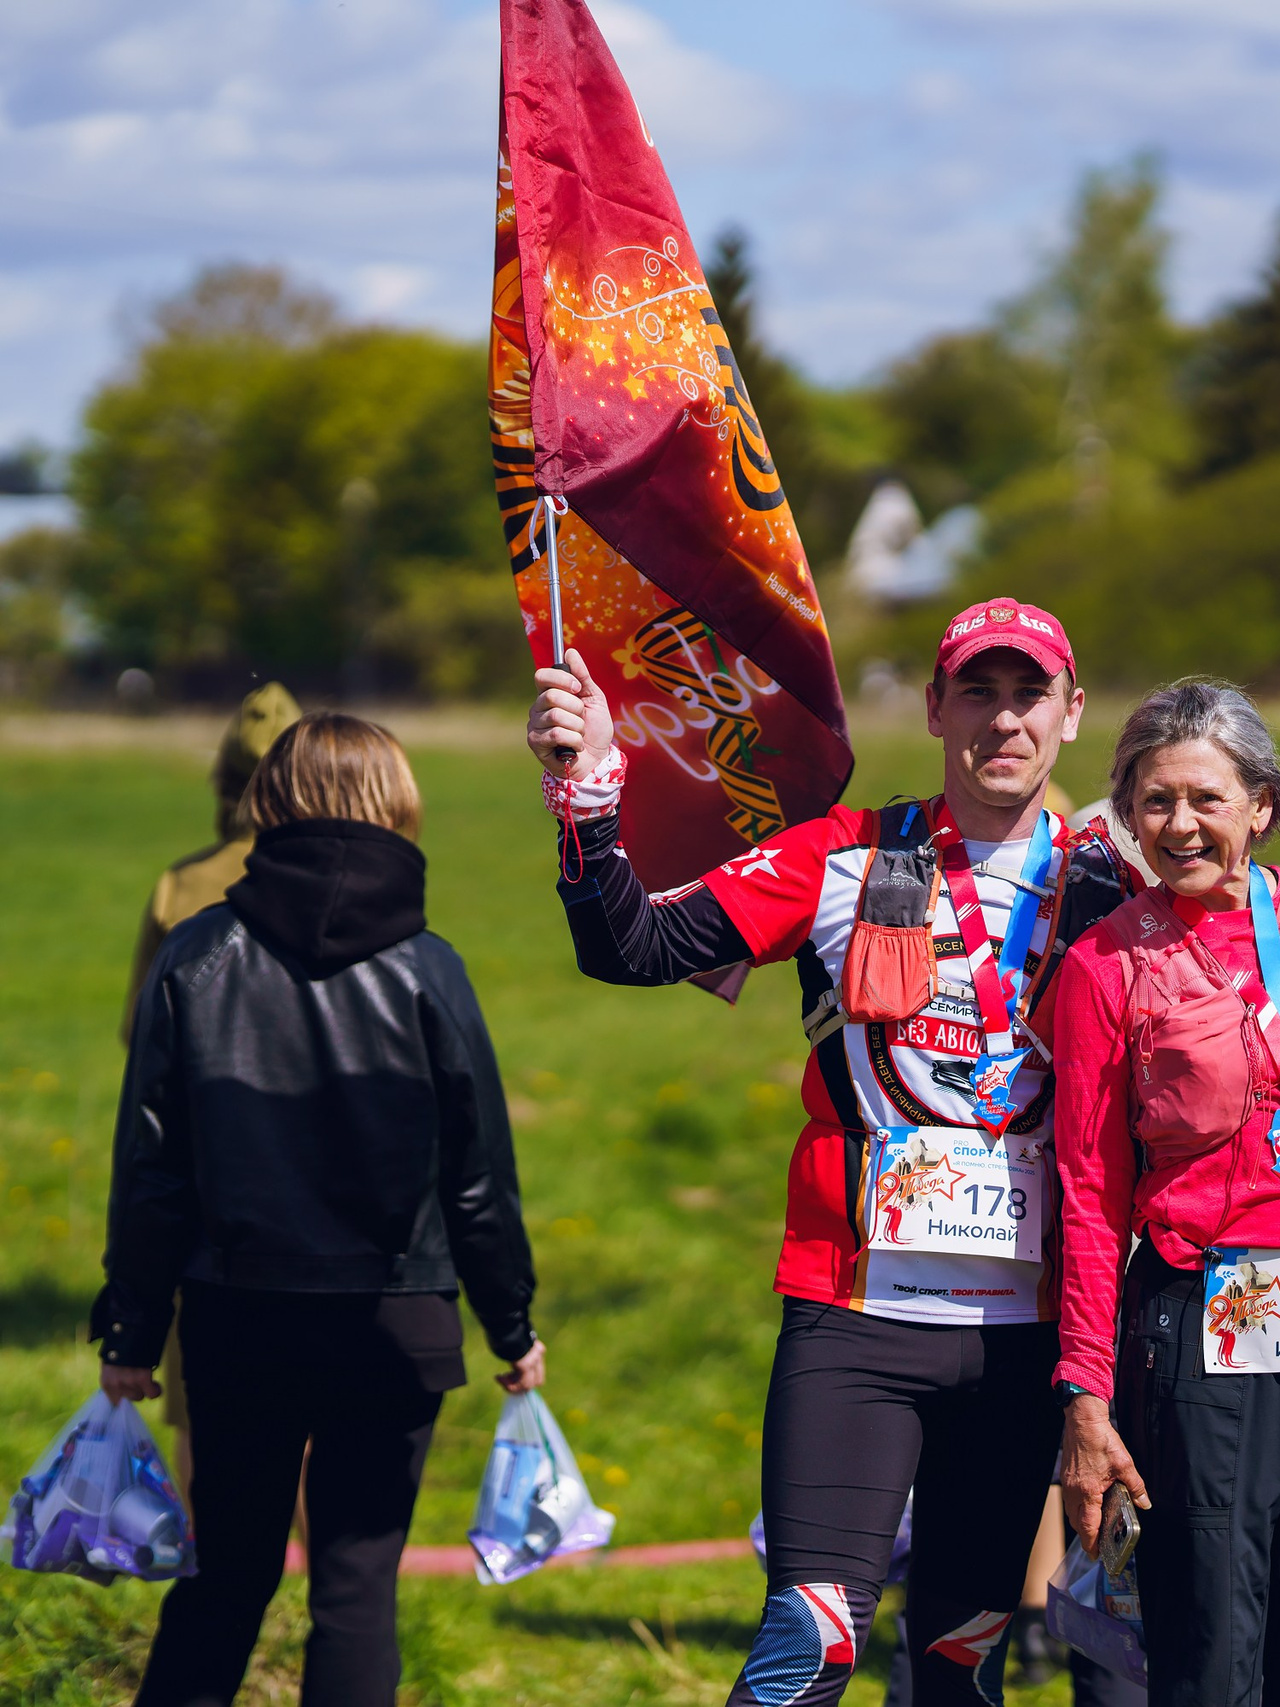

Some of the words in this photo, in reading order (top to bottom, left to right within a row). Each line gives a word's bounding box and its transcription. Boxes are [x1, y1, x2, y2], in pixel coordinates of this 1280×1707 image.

[765, 572, 789, 599] Наша
[953, 1146, 993, 1158] СПОРТ
[995, 1150, 1010, 1160] 40
[964, 1184, 1027, 1221] 178
[928, 1218, 1019, 1243] Николай
[893, 1284, 917, 1293] ТВОЙ
[918, 1288, 949, 1296] СПОРТ.
